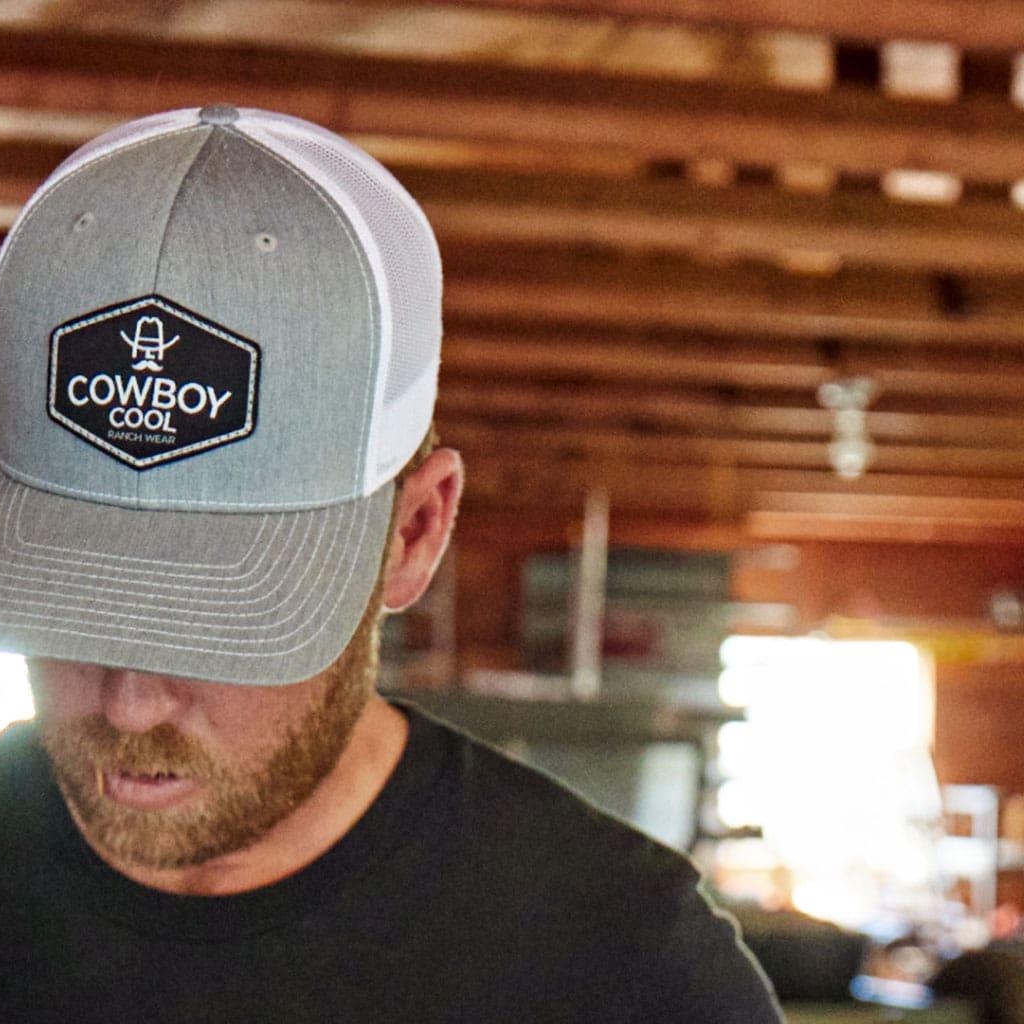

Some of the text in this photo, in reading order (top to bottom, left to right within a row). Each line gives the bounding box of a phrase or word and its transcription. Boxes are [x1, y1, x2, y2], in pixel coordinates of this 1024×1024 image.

[67, 374, 232, 419] COWBOY
[109, 407, 176, 432] COOL
[107, 430, 176, 444] RANCH WEAR
